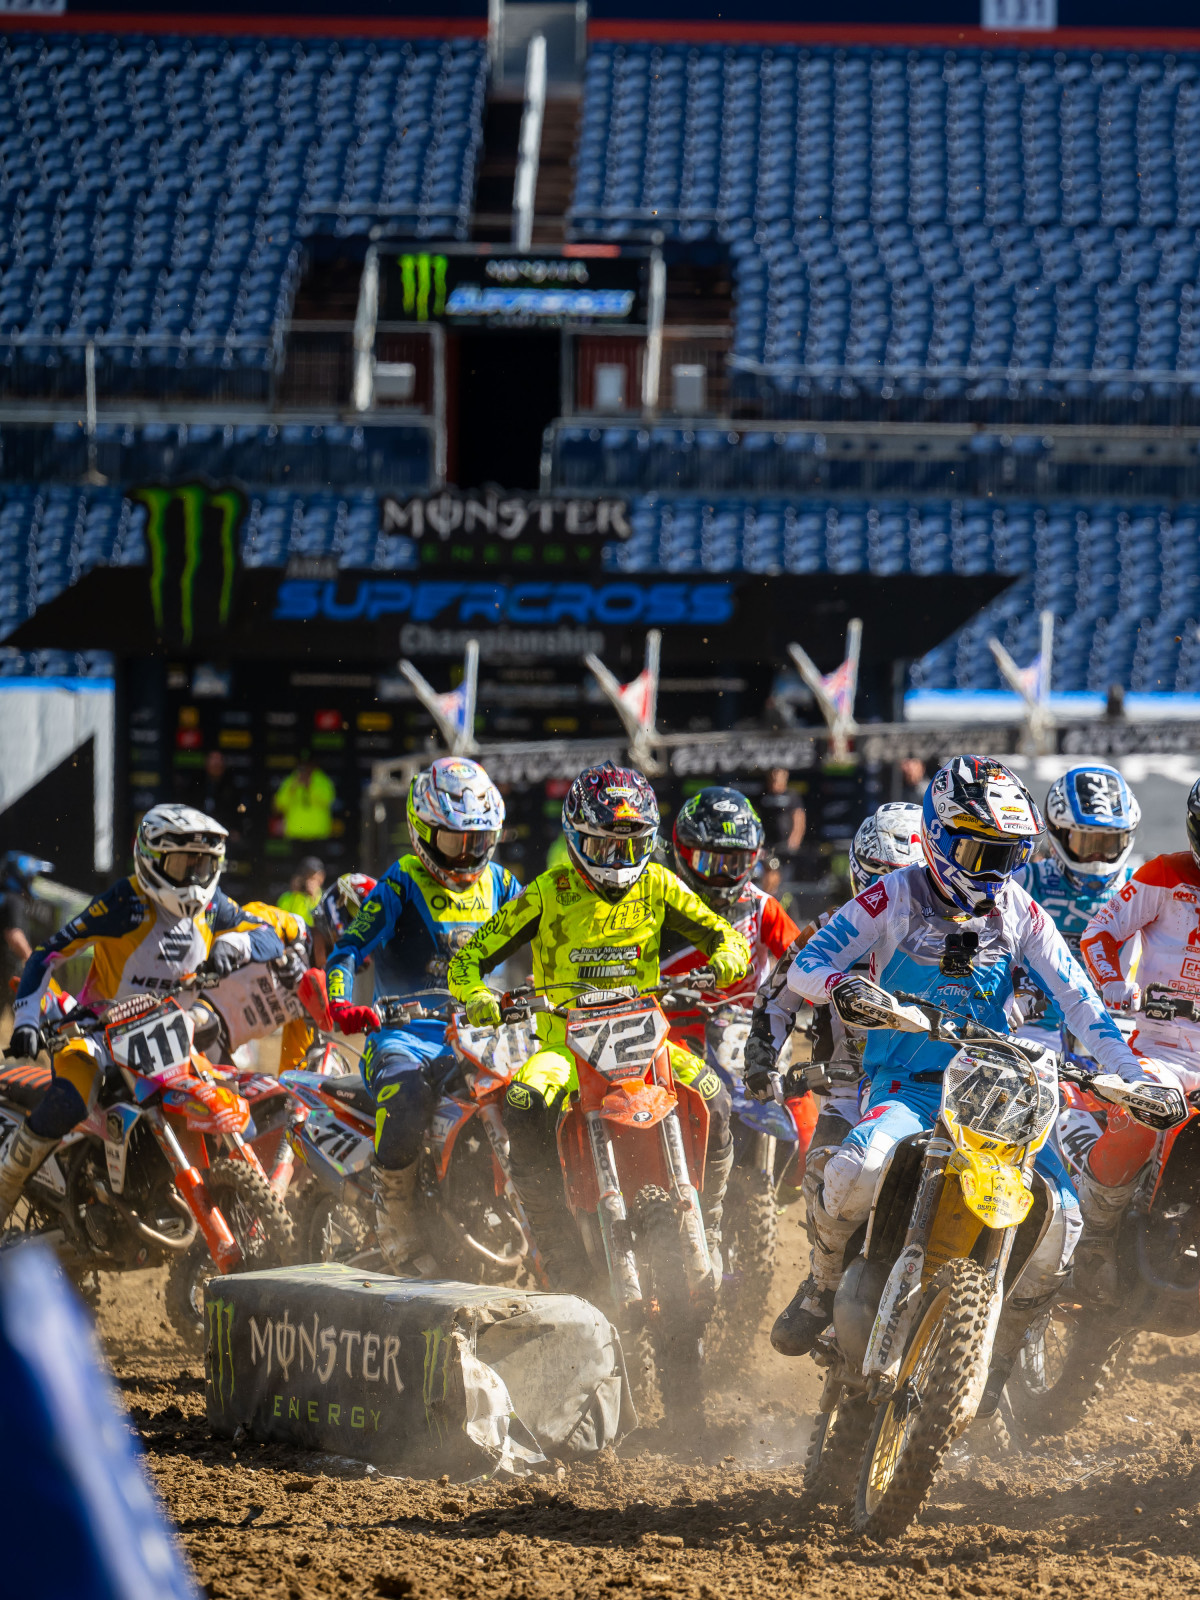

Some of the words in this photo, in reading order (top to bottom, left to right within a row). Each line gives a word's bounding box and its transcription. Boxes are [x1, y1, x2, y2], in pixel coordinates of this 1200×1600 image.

[381, 492, 632, 540] MONSTER
[274, 581, 734, 624] SUPERCROSS
[126, 1014, 191, 1077] 411
[568, 1012, 657, 1068] 72
[247, 1307, 406, 1394] MONSTER
[272, 1394, 383, 1431] ENERGY
